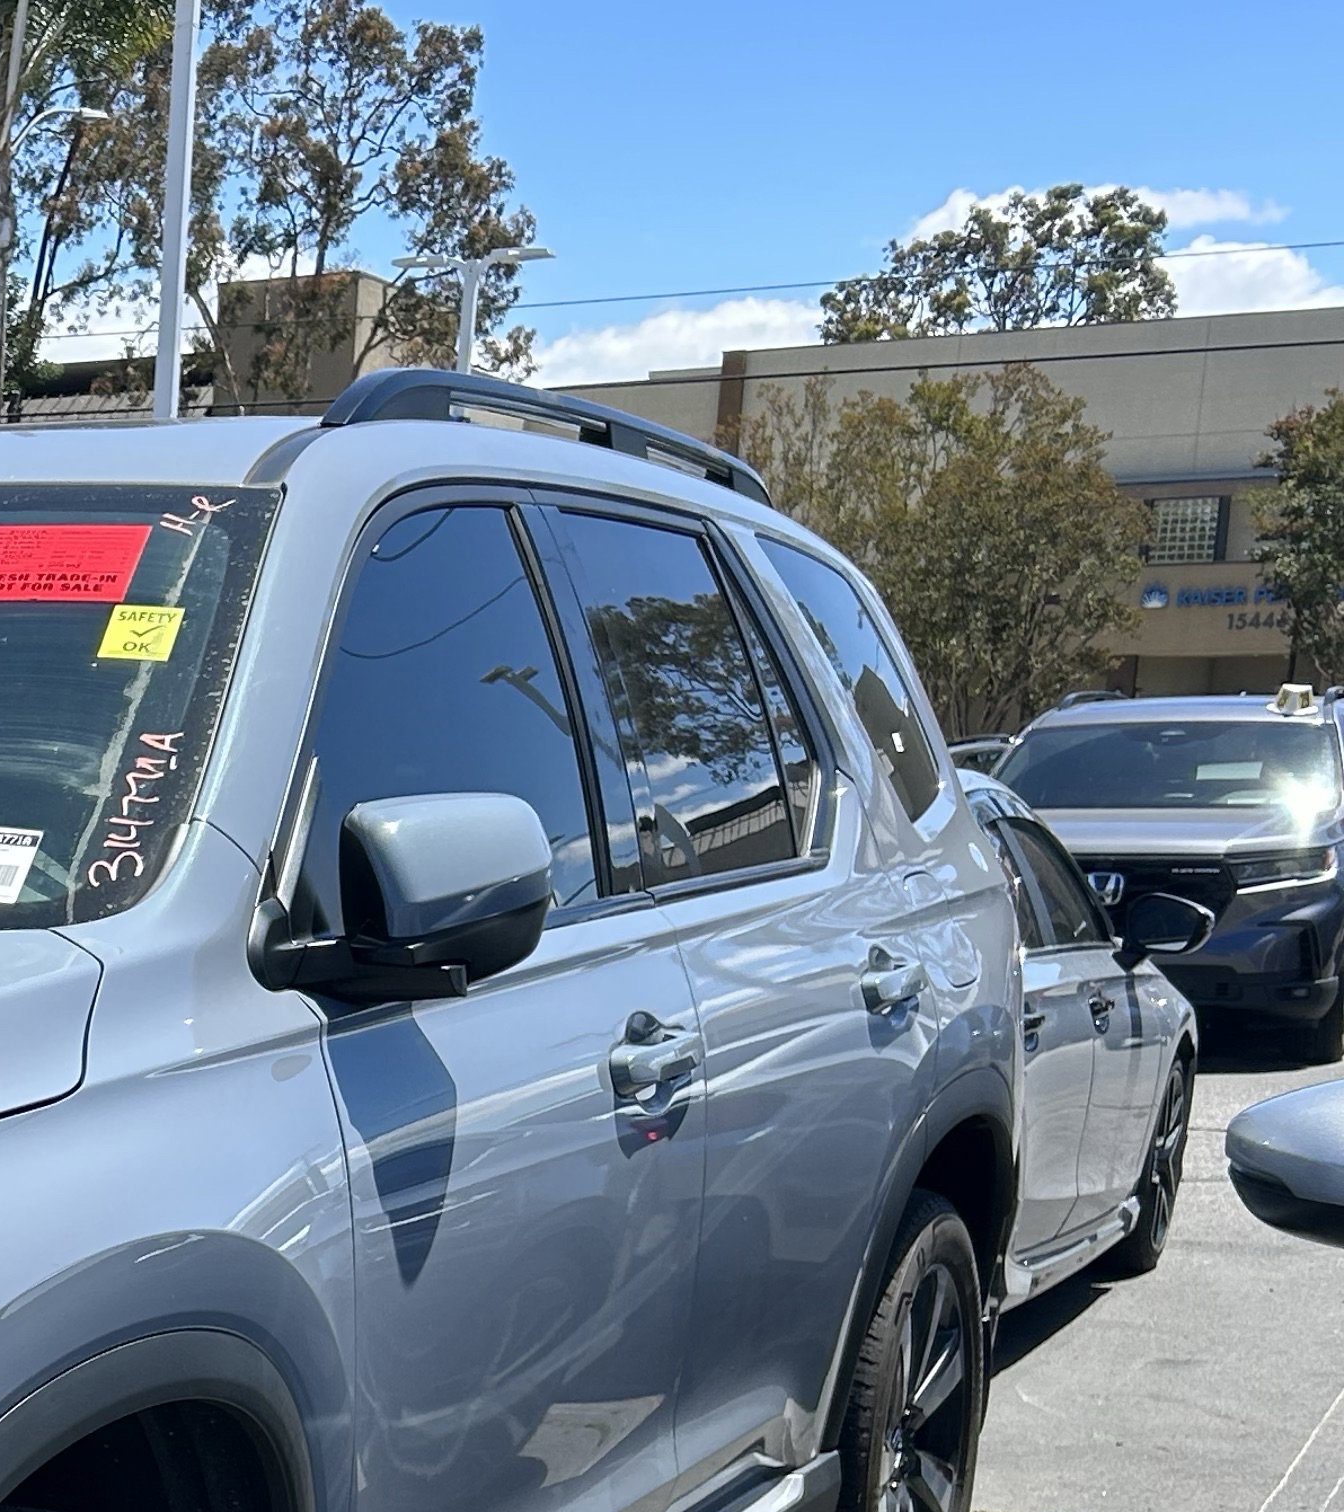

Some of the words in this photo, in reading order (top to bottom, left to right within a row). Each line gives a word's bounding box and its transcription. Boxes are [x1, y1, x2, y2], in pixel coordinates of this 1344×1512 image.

[37, 573, 118, 583] TRADE-IN
[20, 582, 54, 592] FOR
[60, 582, 104, 593] SALE
[117, 610, 178, 624] SAFETY
[122, 641, 152, 653] OK
